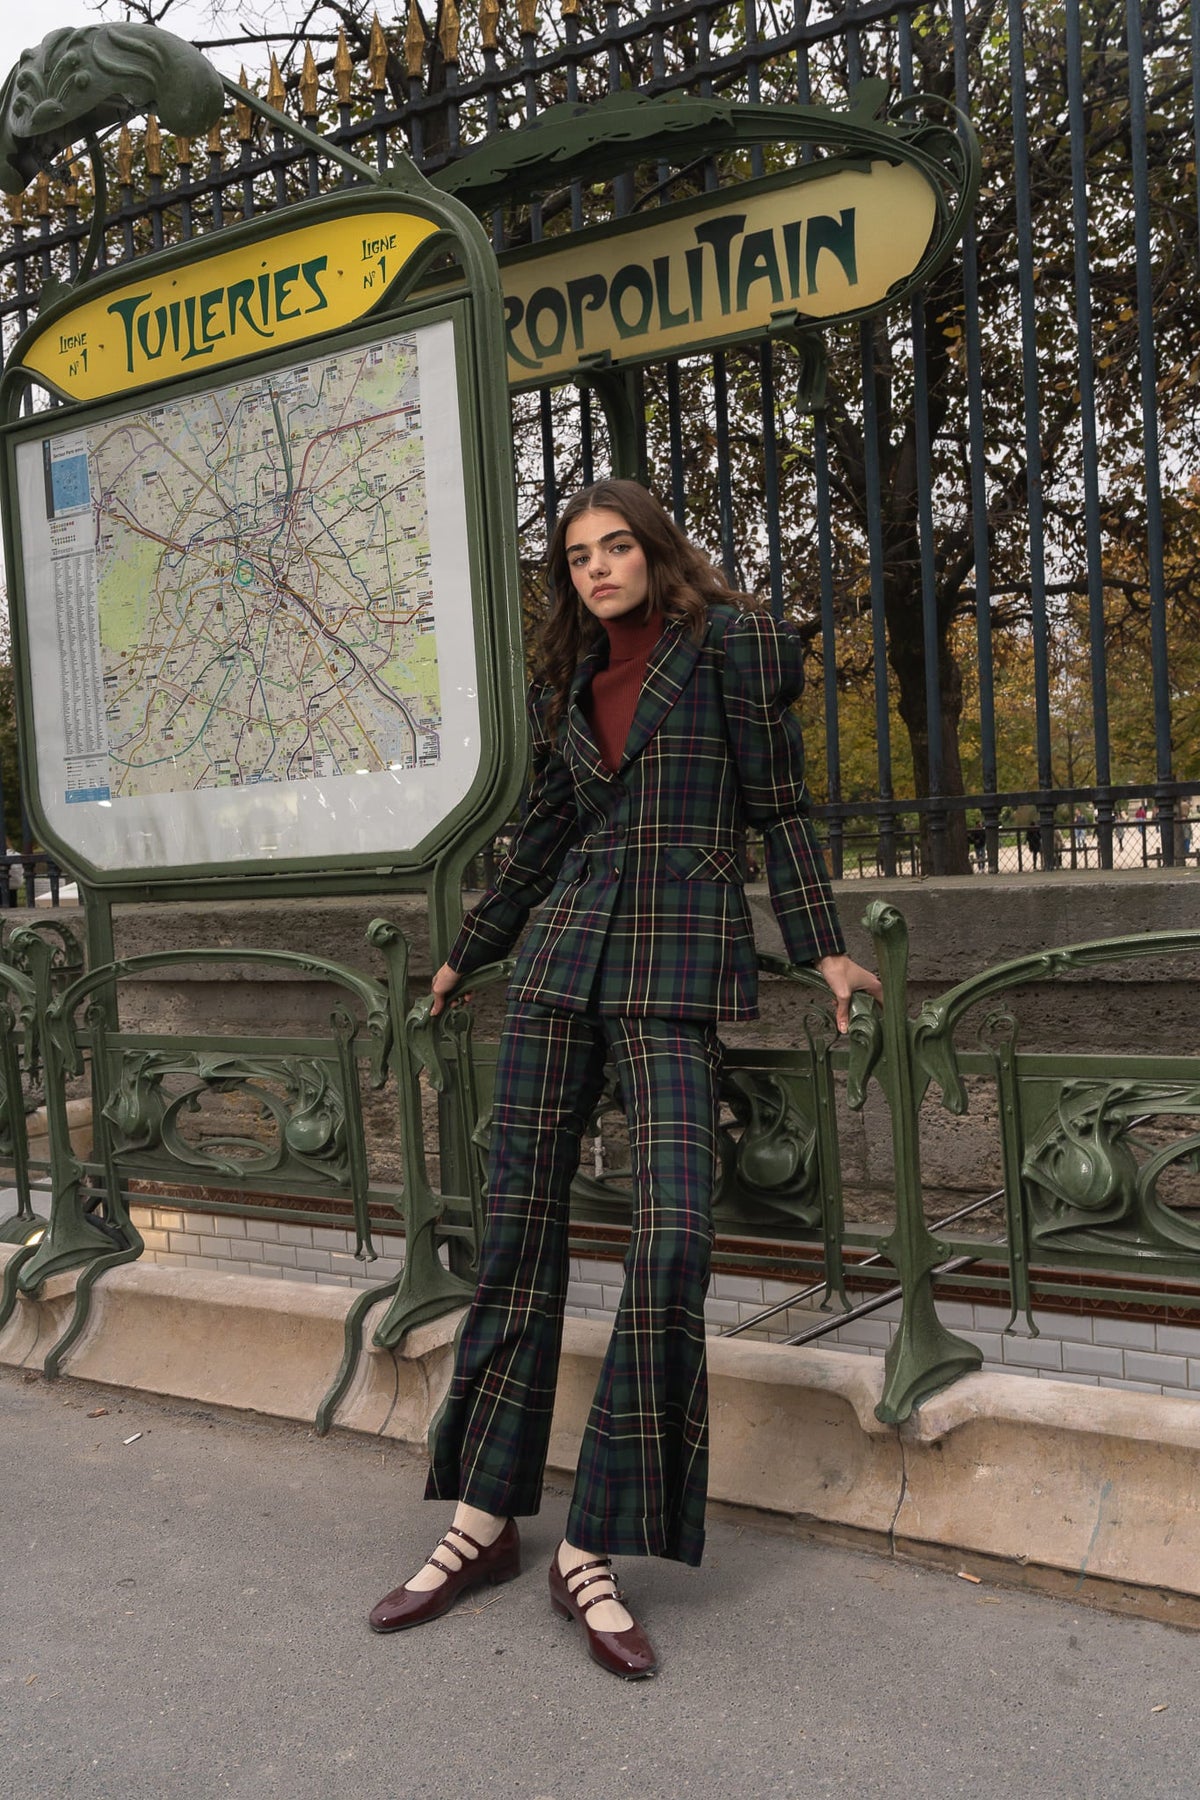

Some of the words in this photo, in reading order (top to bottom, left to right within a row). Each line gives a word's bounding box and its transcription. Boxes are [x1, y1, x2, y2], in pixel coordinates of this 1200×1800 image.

[361, 234, 397, 261] LIGNE
[377, 255, 386, 284] 1
[106, 254, 328, 373] TUILERIES
[59, 332, 88, 355] LIGNE
[80, 348, 88, 373] 1
